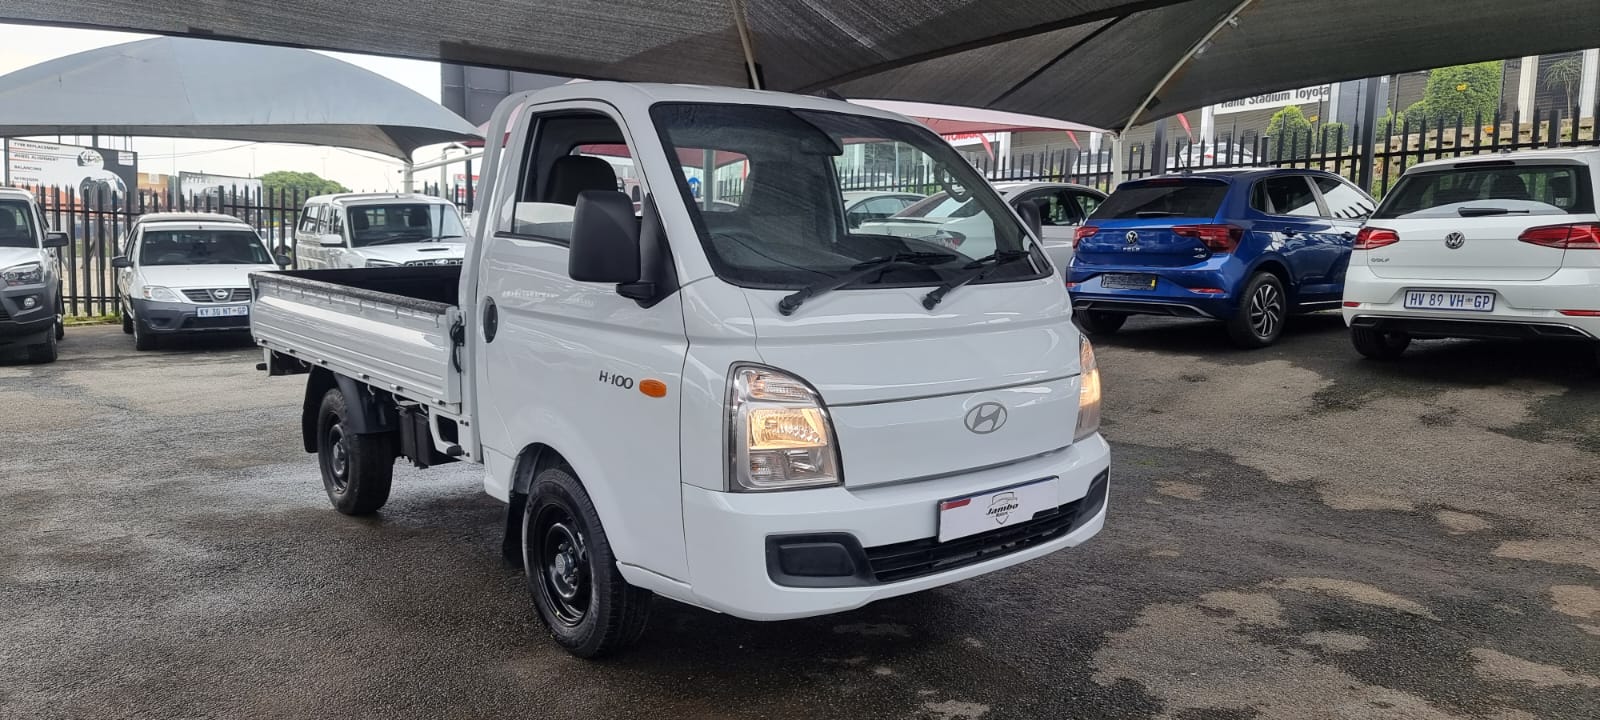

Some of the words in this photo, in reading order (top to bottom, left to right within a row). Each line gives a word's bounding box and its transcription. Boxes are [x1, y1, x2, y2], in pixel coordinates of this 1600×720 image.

[1295, 86, 1329, 100] Toyota
[1410, 293, 1425, 306] HV
[1429, 293, 1444, 306] 89
[1450, 294, 1465, 307] VH
[1474, 295, 1490, 309] GP
